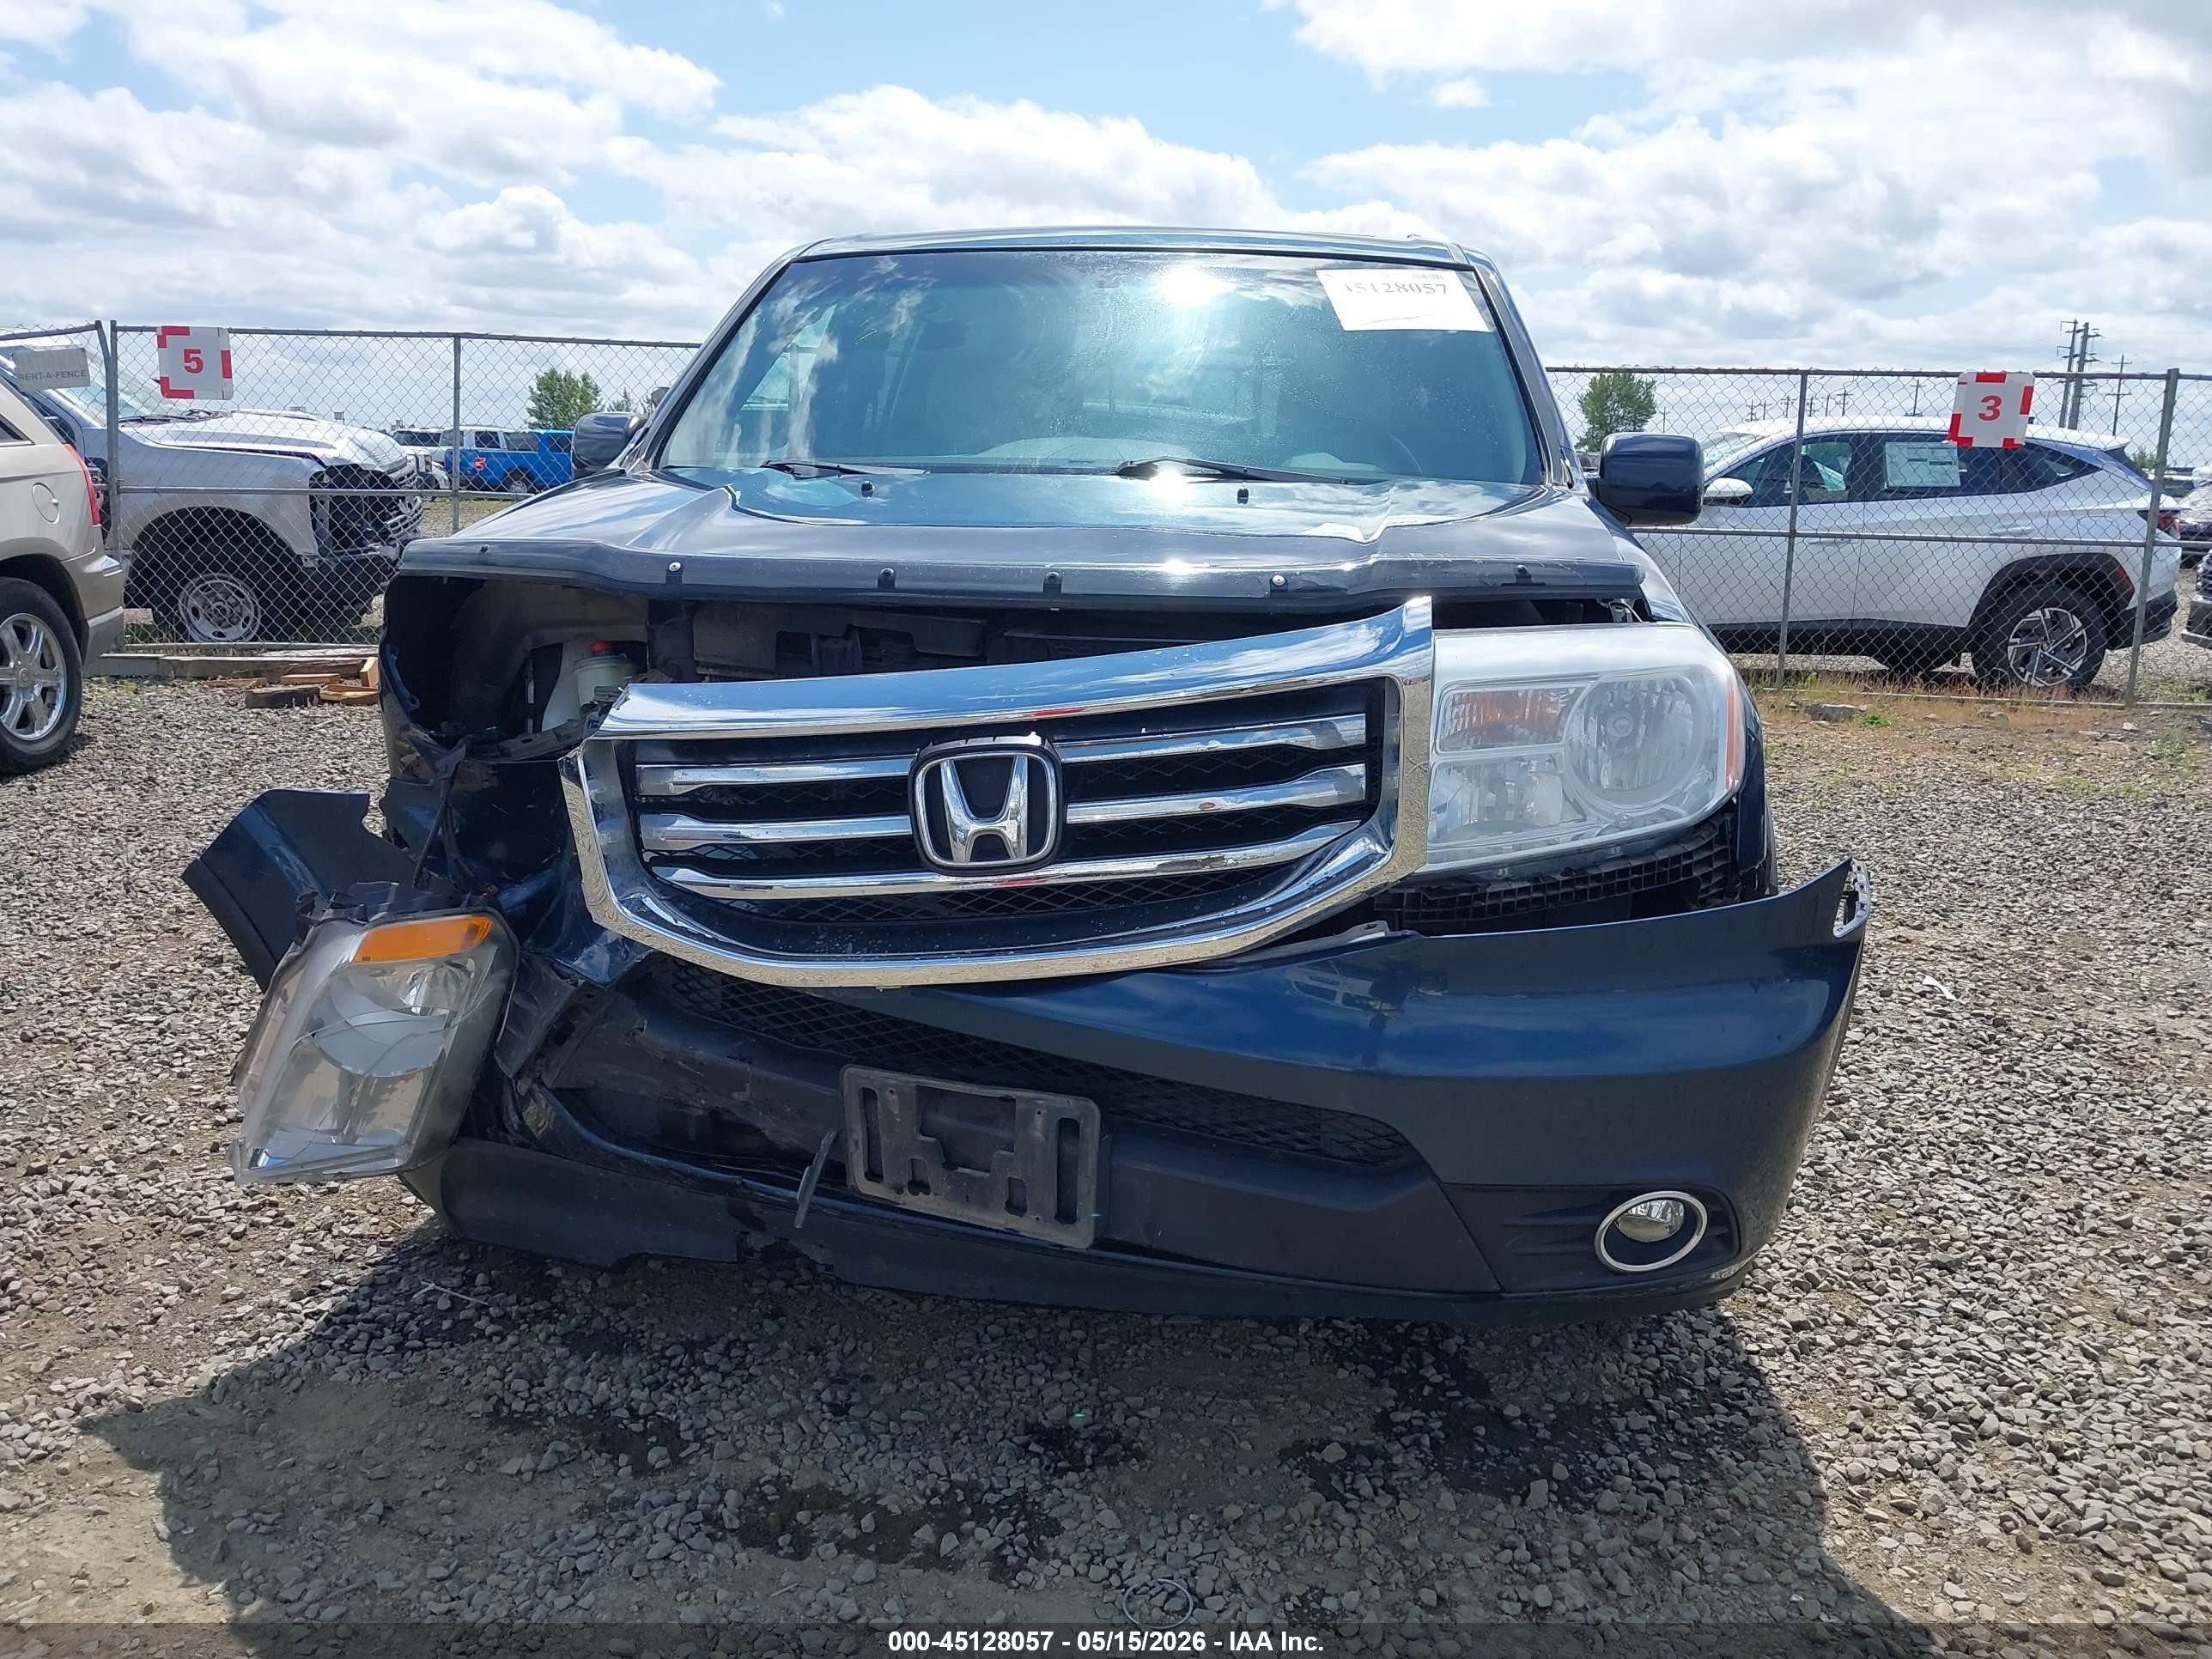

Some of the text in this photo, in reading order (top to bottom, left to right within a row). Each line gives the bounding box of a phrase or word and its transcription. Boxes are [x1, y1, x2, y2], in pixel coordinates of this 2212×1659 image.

[184, 349, 204, 374] 5
[18, 369, 87, 381] RENT-A-FENCE
[1978, 395, 2002, 422] 3
[939, 755, 1029, 864] H
